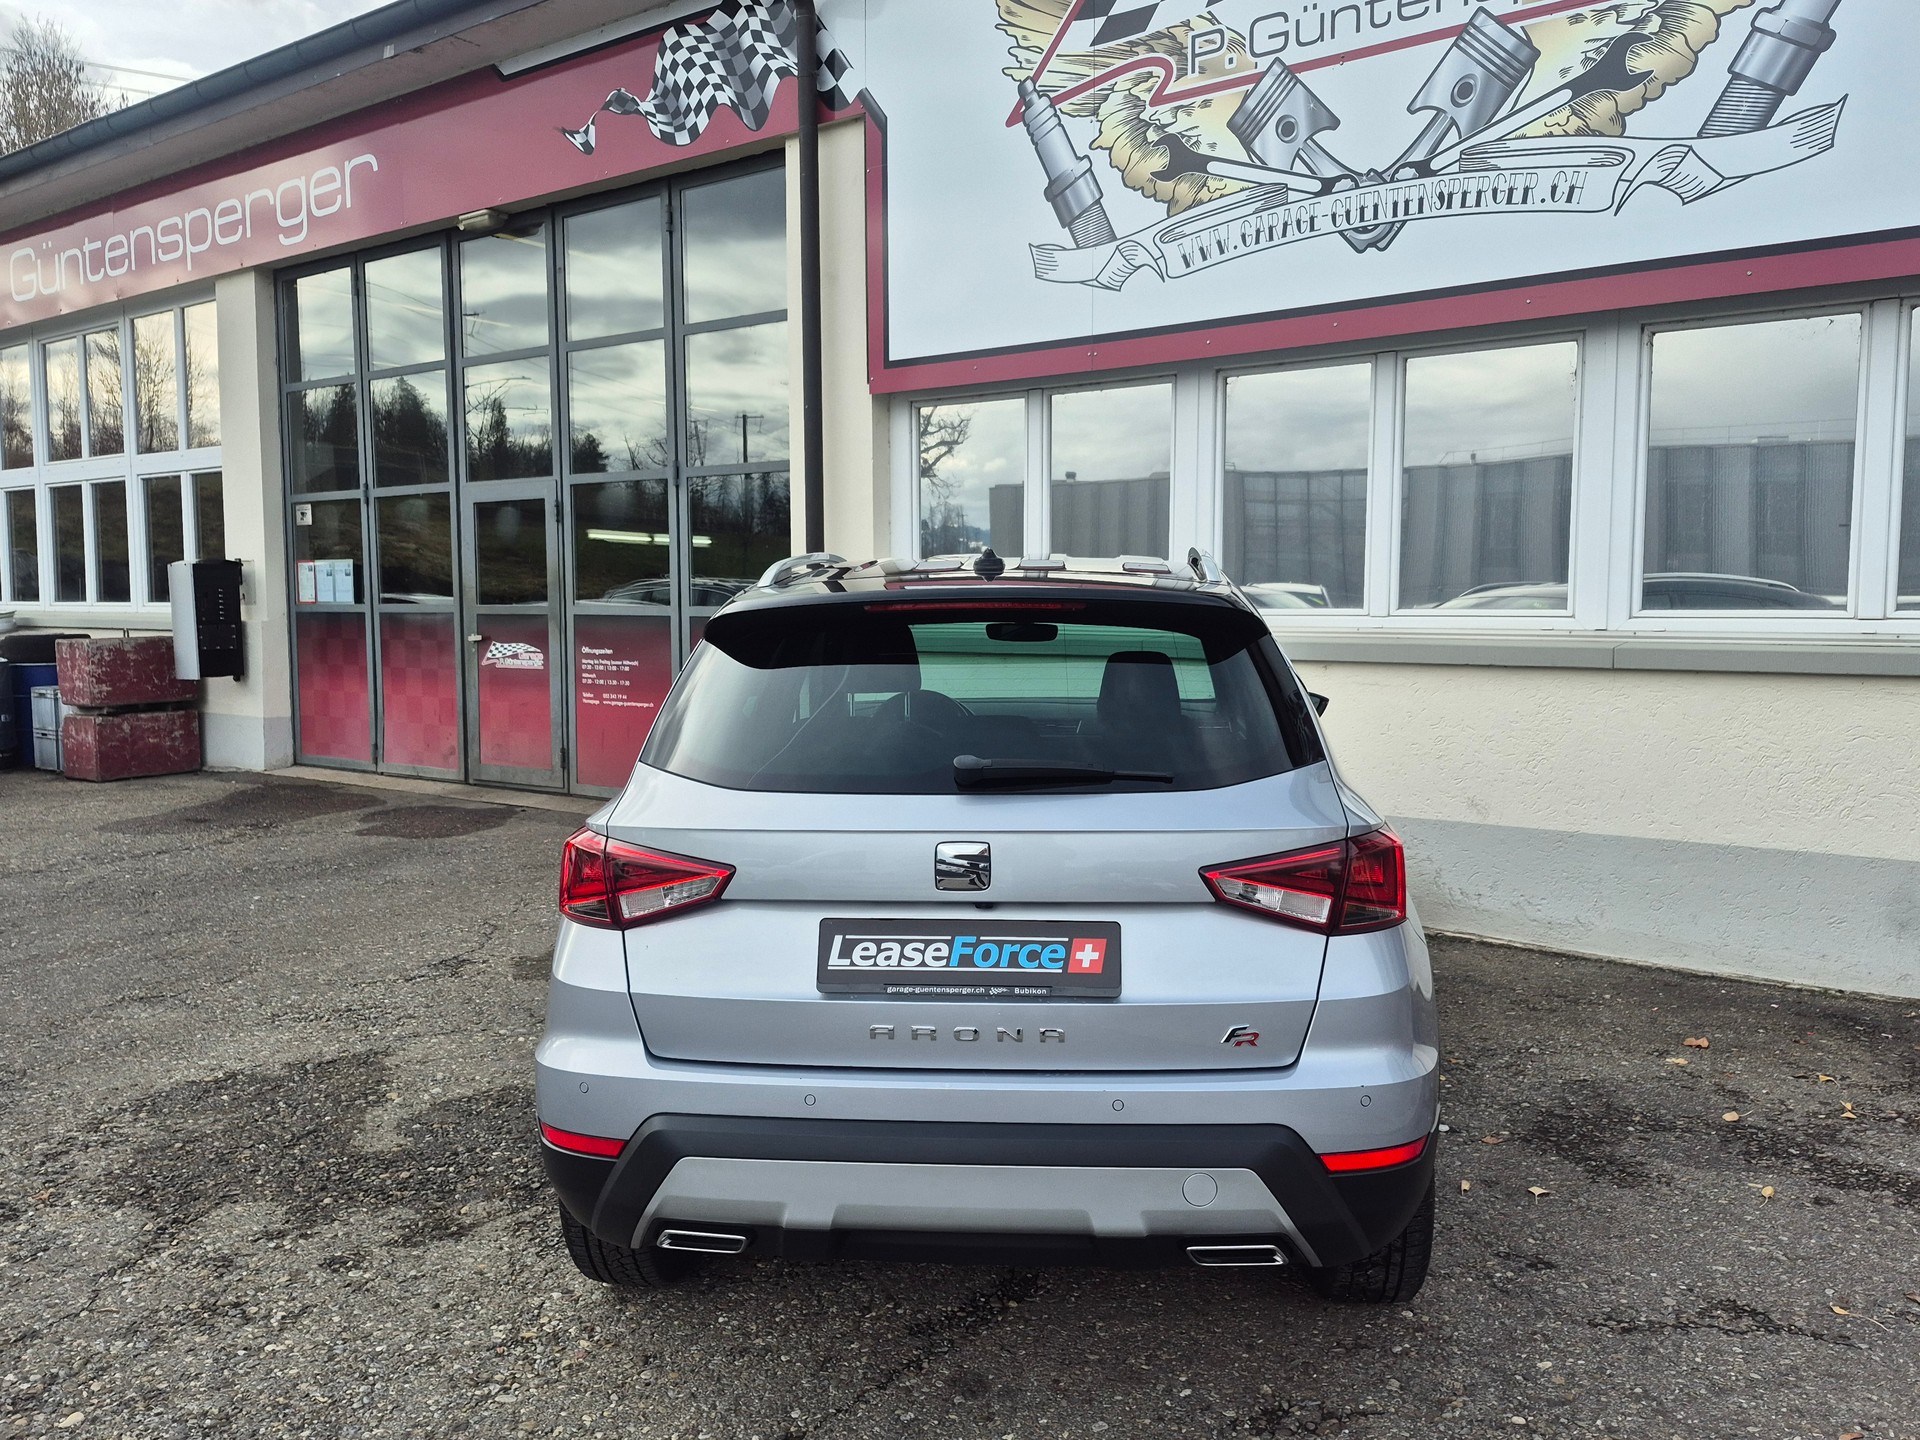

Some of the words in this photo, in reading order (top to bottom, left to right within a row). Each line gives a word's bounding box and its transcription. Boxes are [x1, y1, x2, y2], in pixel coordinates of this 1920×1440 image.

[10, 153, 378, 302] Güntensperger
[1177, 170, 1588, 269] WWW.GARAGE-GUENTENSPERGER.CH
[582, 646, 613, 655] Öffnungszeiten
[828, 934, 1066, 968] LeaseForce
[886, 985, 985, 995] garage-guentensperger.ch
[1014, 987, 1047, 995] Bubikon
[869, 1024, 1066, 1043] ARONA
[1220, 1024, 1259, 1047] FR
